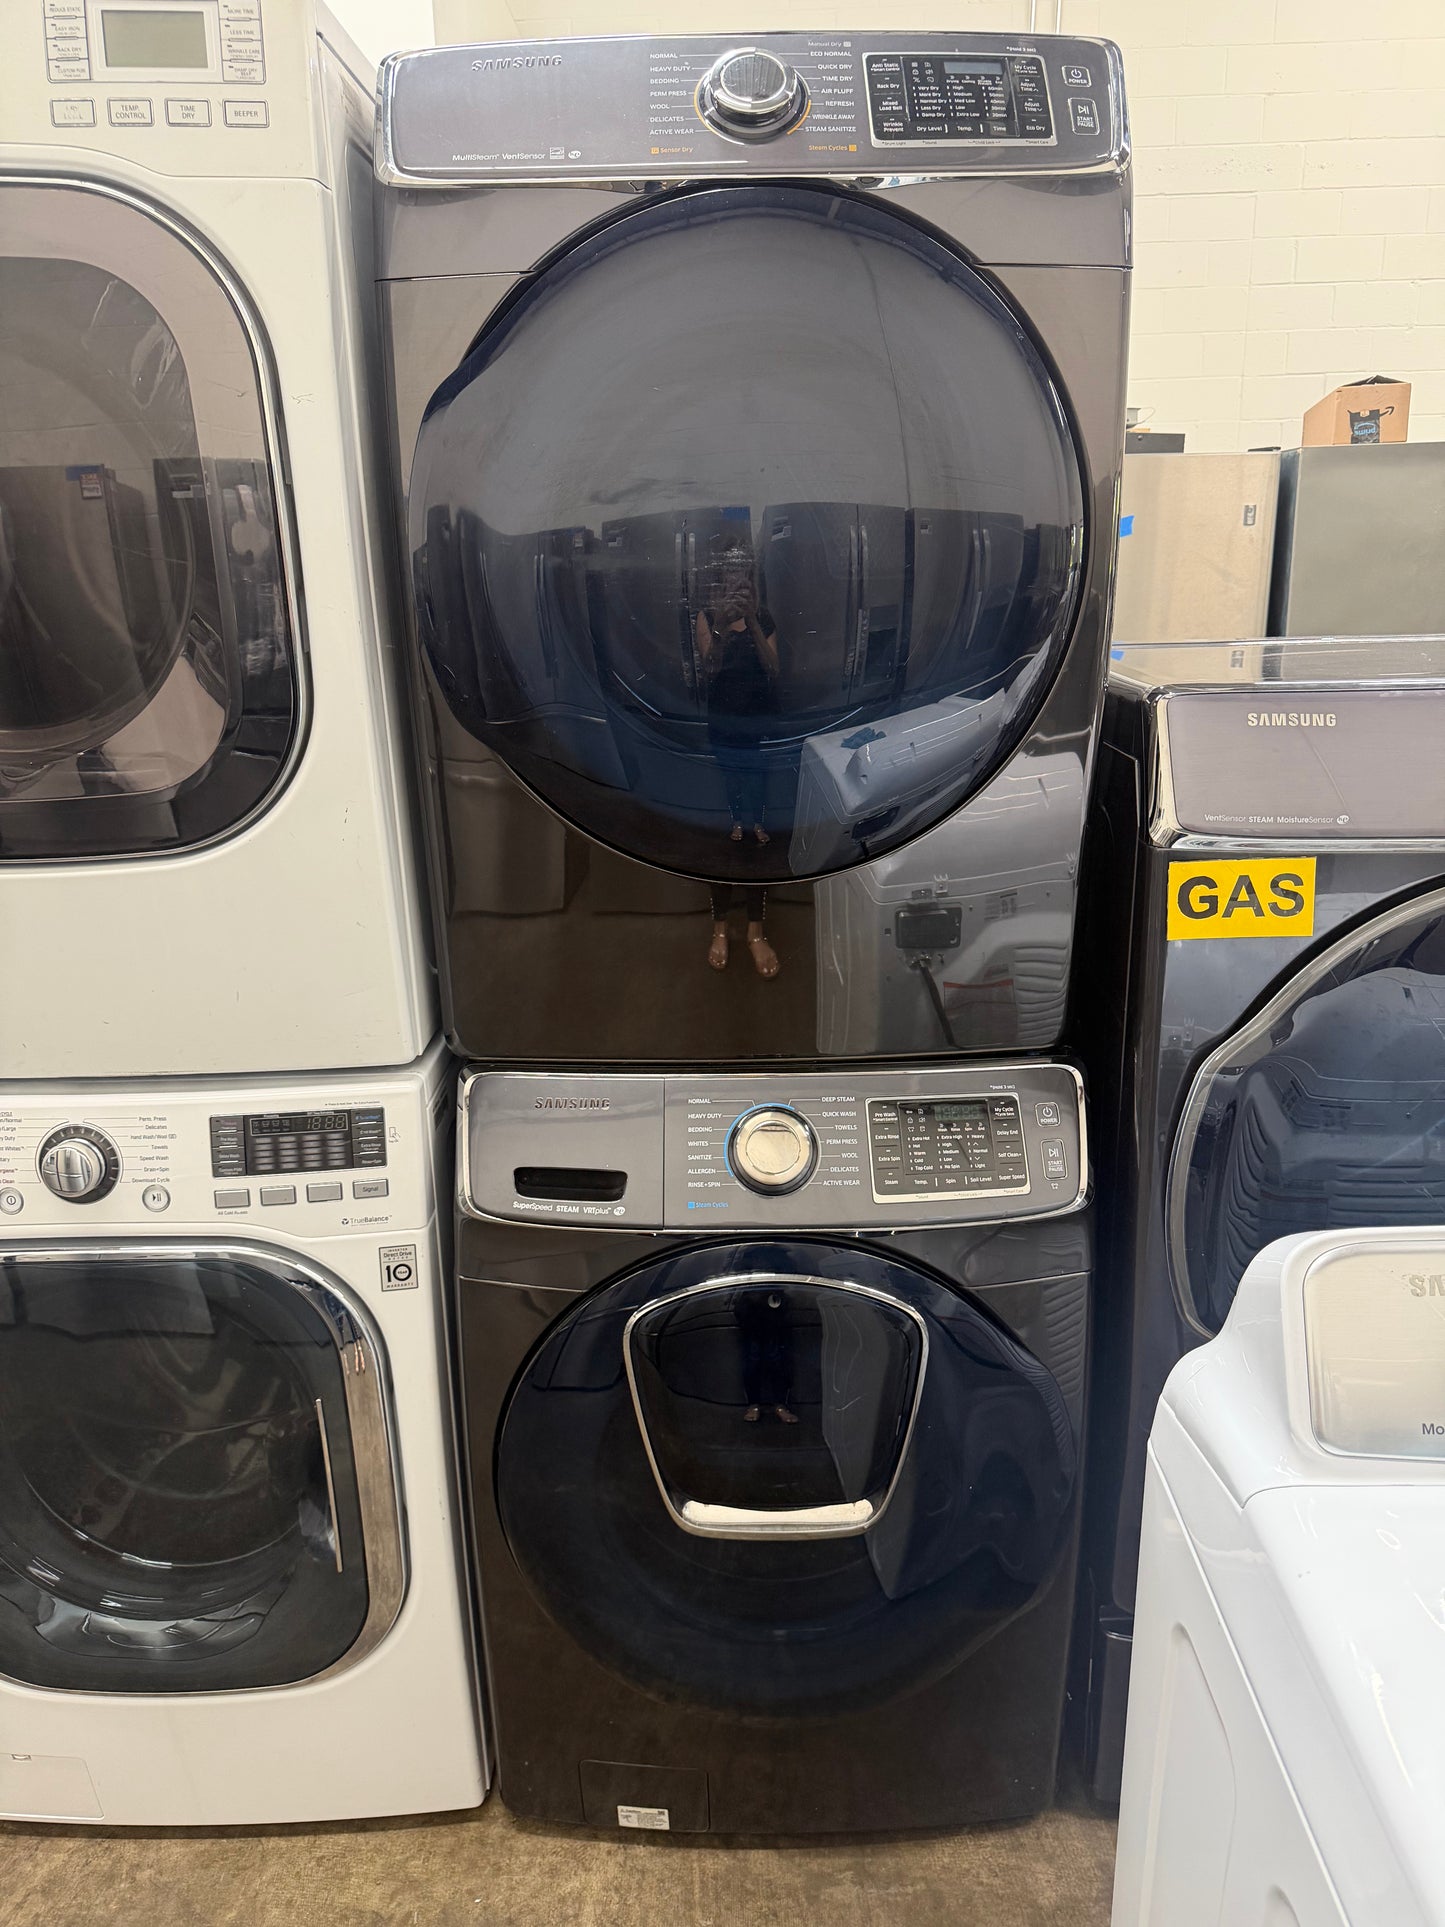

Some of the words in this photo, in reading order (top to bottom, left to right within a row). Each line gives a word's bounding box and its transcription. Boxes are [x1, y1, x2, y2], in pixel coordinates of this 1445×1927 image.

[472, 55, 562, 71] SAMSUNG
[1248, 713, 1336, 726] SAMSUNG
[1177, 873, 1305, 920] GAS
[535, 1097, 610, 1110] SAMSUNG
[513, 1201, 552, 1211] SuperSpeed
[386, 1264, 412, 1282] 10
